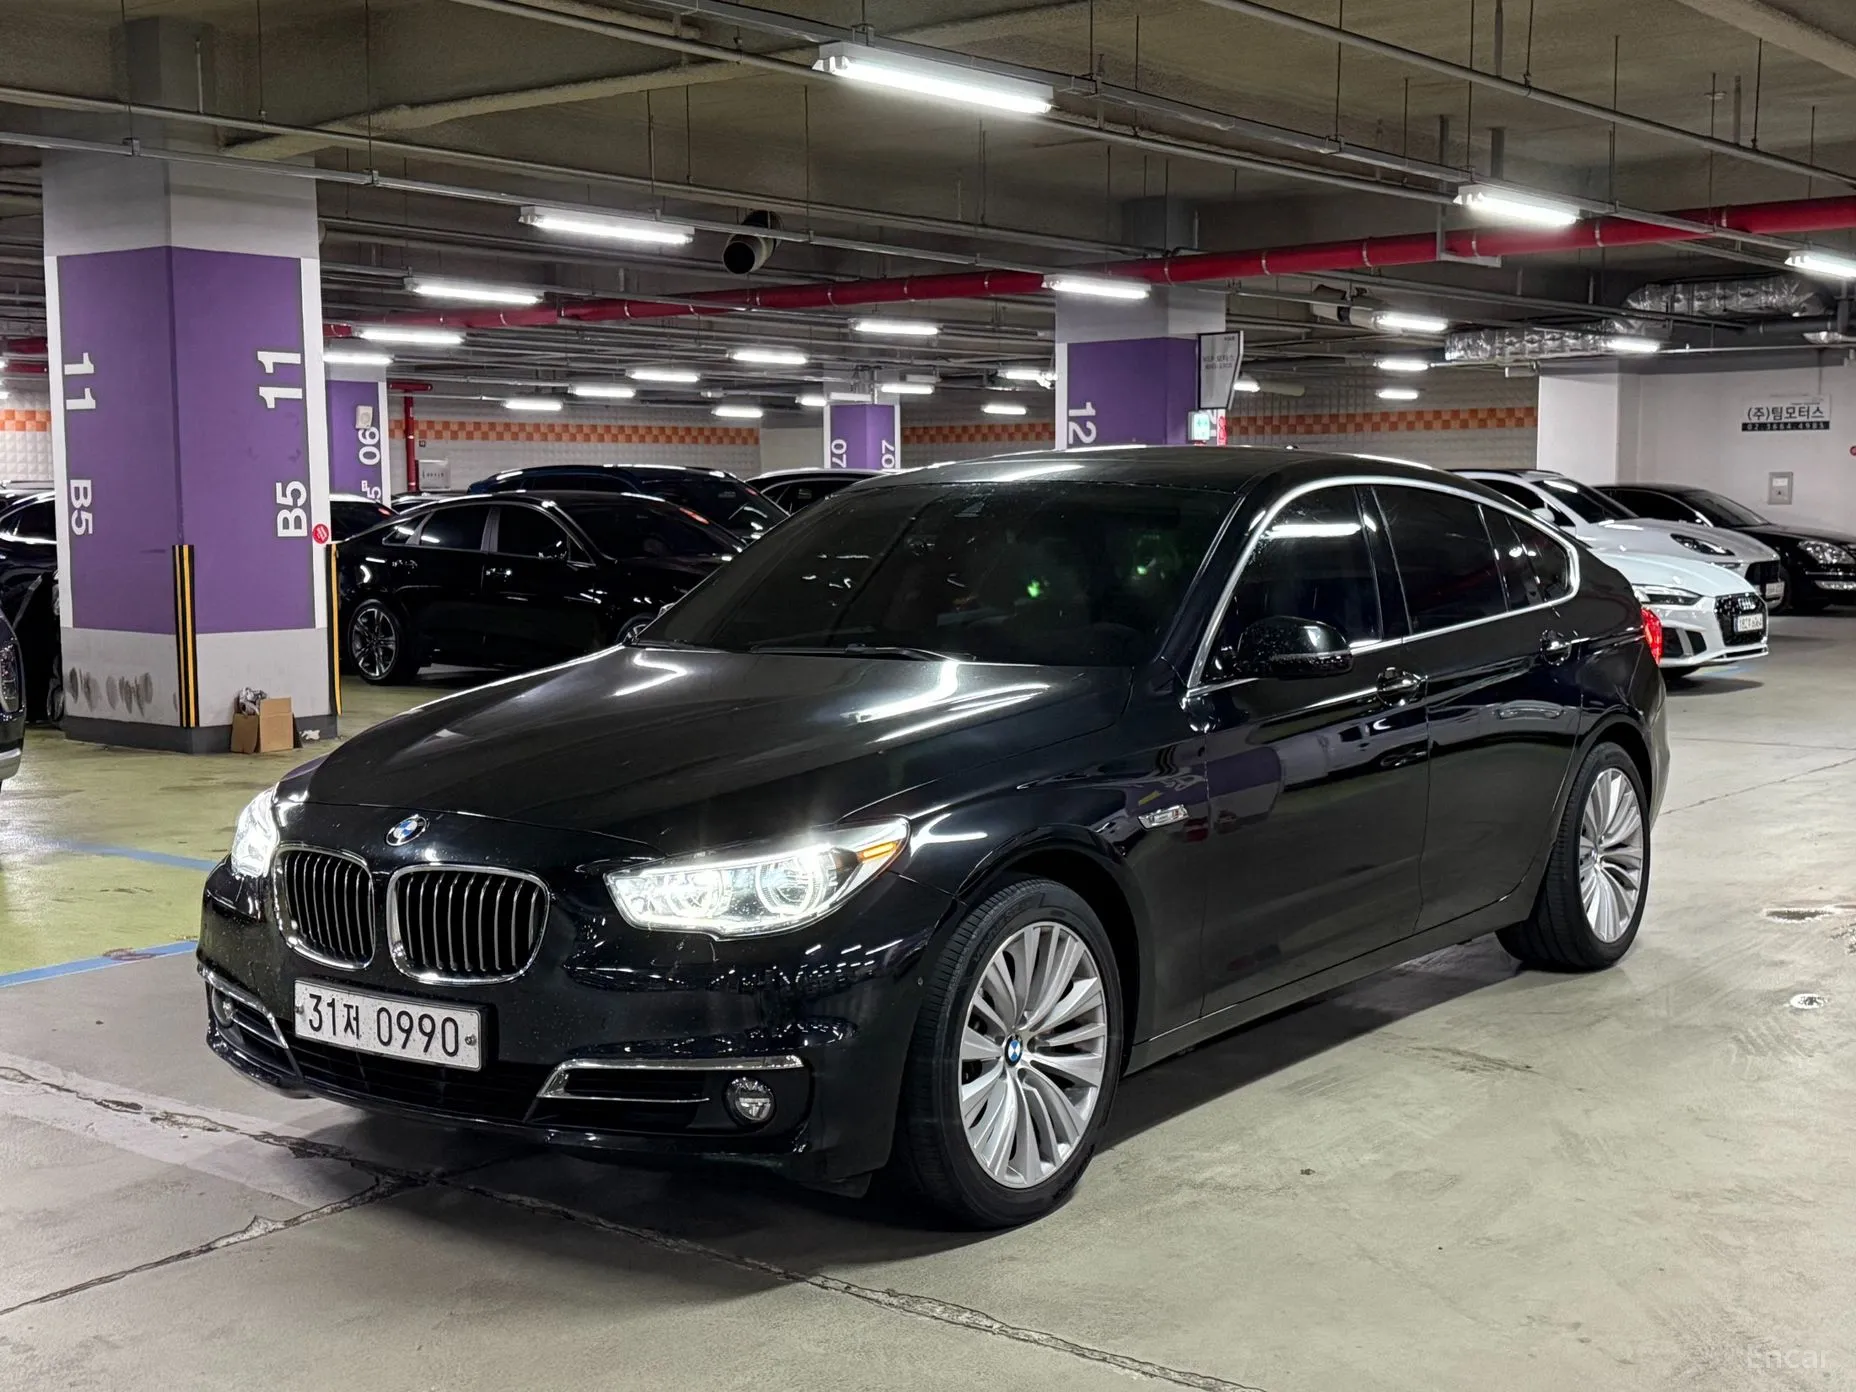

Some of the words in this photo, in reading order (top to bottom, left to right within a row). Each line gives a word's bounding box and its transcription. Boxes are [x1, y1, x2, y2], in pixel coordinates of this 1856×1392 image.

[64, 352, 97, 411] 11
[257, 350, 303, 409] 11
[357, 426, 381, 466] 06
[1068, 401, 1097, 445] 12
[831, 438, 848, 469] 07
[881, 439, 896, 469] 07
[69, 479, 93, 536] B5
[275, 480, 308, 537] B5
[308, 993, 361, 1040] 31저
[376, 1006, 460, 1058] 0990
